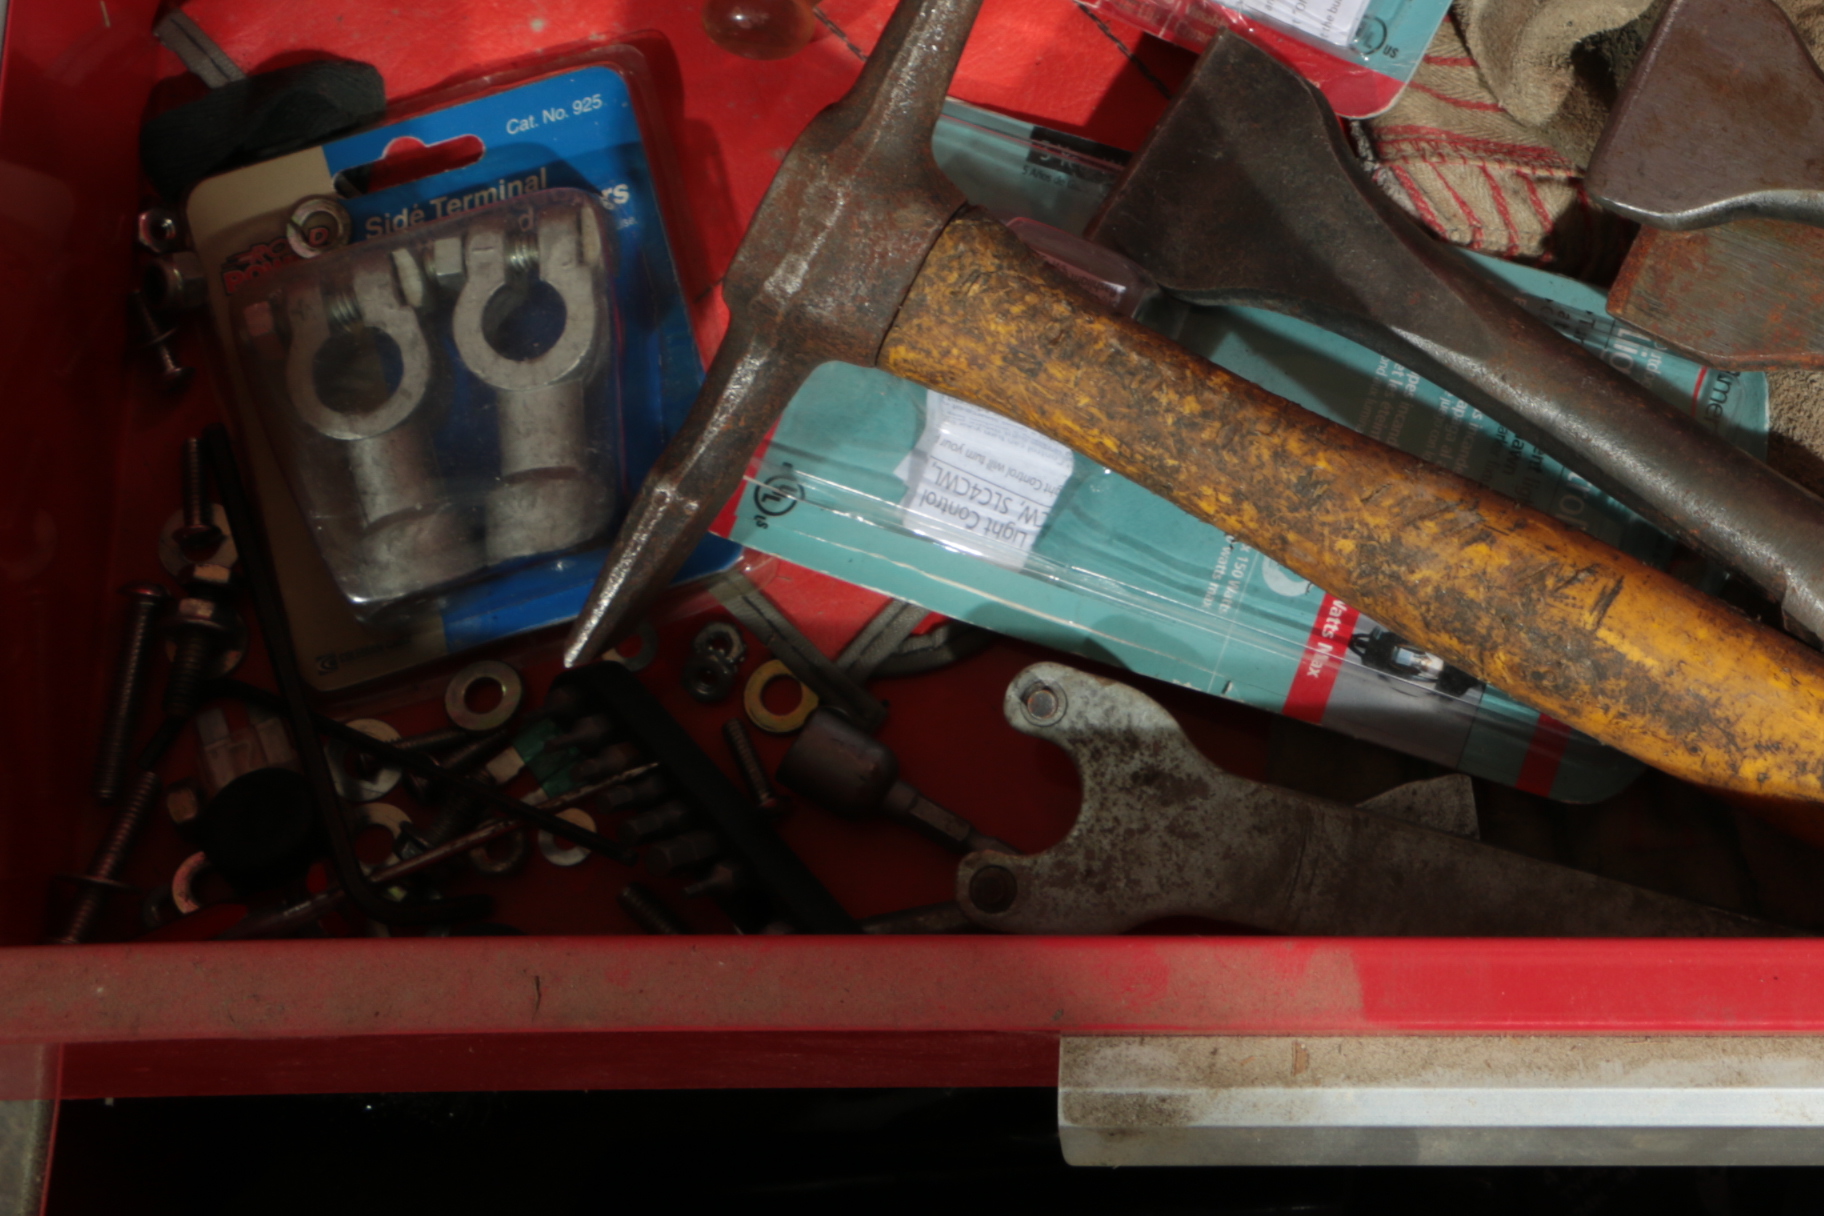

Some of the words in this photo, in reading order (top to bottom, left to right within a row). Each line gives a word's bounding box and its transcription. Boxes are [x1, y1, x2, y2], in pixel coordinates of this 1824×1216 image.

[504, 112, 539, 136] Cat.
[540, 104, 570, 125] No.
[570, 92, 605, 116] 925
[361, 202, 428, 240] Side
[430, 168, 548, 222] Terminal
[939, 435, 965, 455] your
[1004, 465, 1044, 492] Control
[917, 488, 983, 531] Control
[981, 513, 1030, 549] Light
[1230, 554, 1249, 579] 150
[1306, 641, 1333, 680] Max
